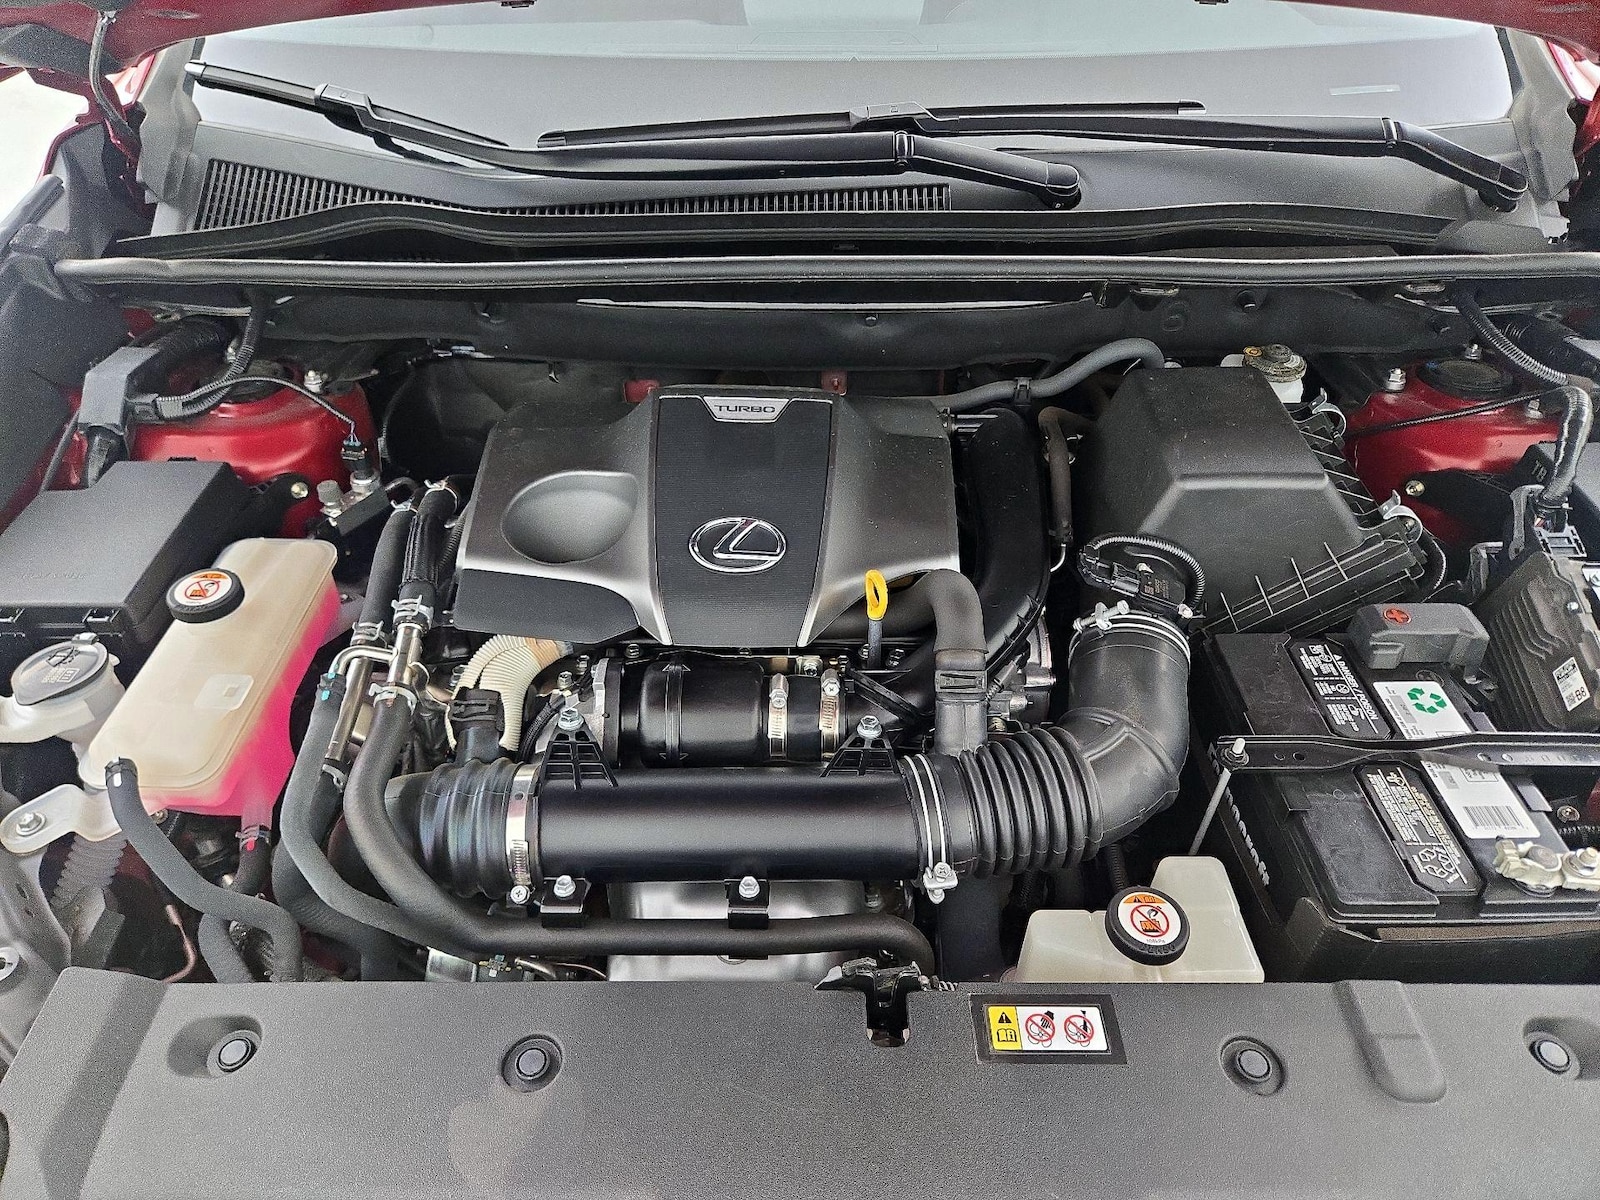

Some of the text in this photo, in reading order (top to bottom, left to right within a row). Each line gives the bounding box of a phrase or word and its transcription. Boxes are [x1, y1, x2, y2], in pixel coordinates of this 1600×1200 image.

[714, 405, 776, 413] TURBO
[1336, 661, 1359, 688] DANGER
[1356, 693, 1379, 720] POISON
